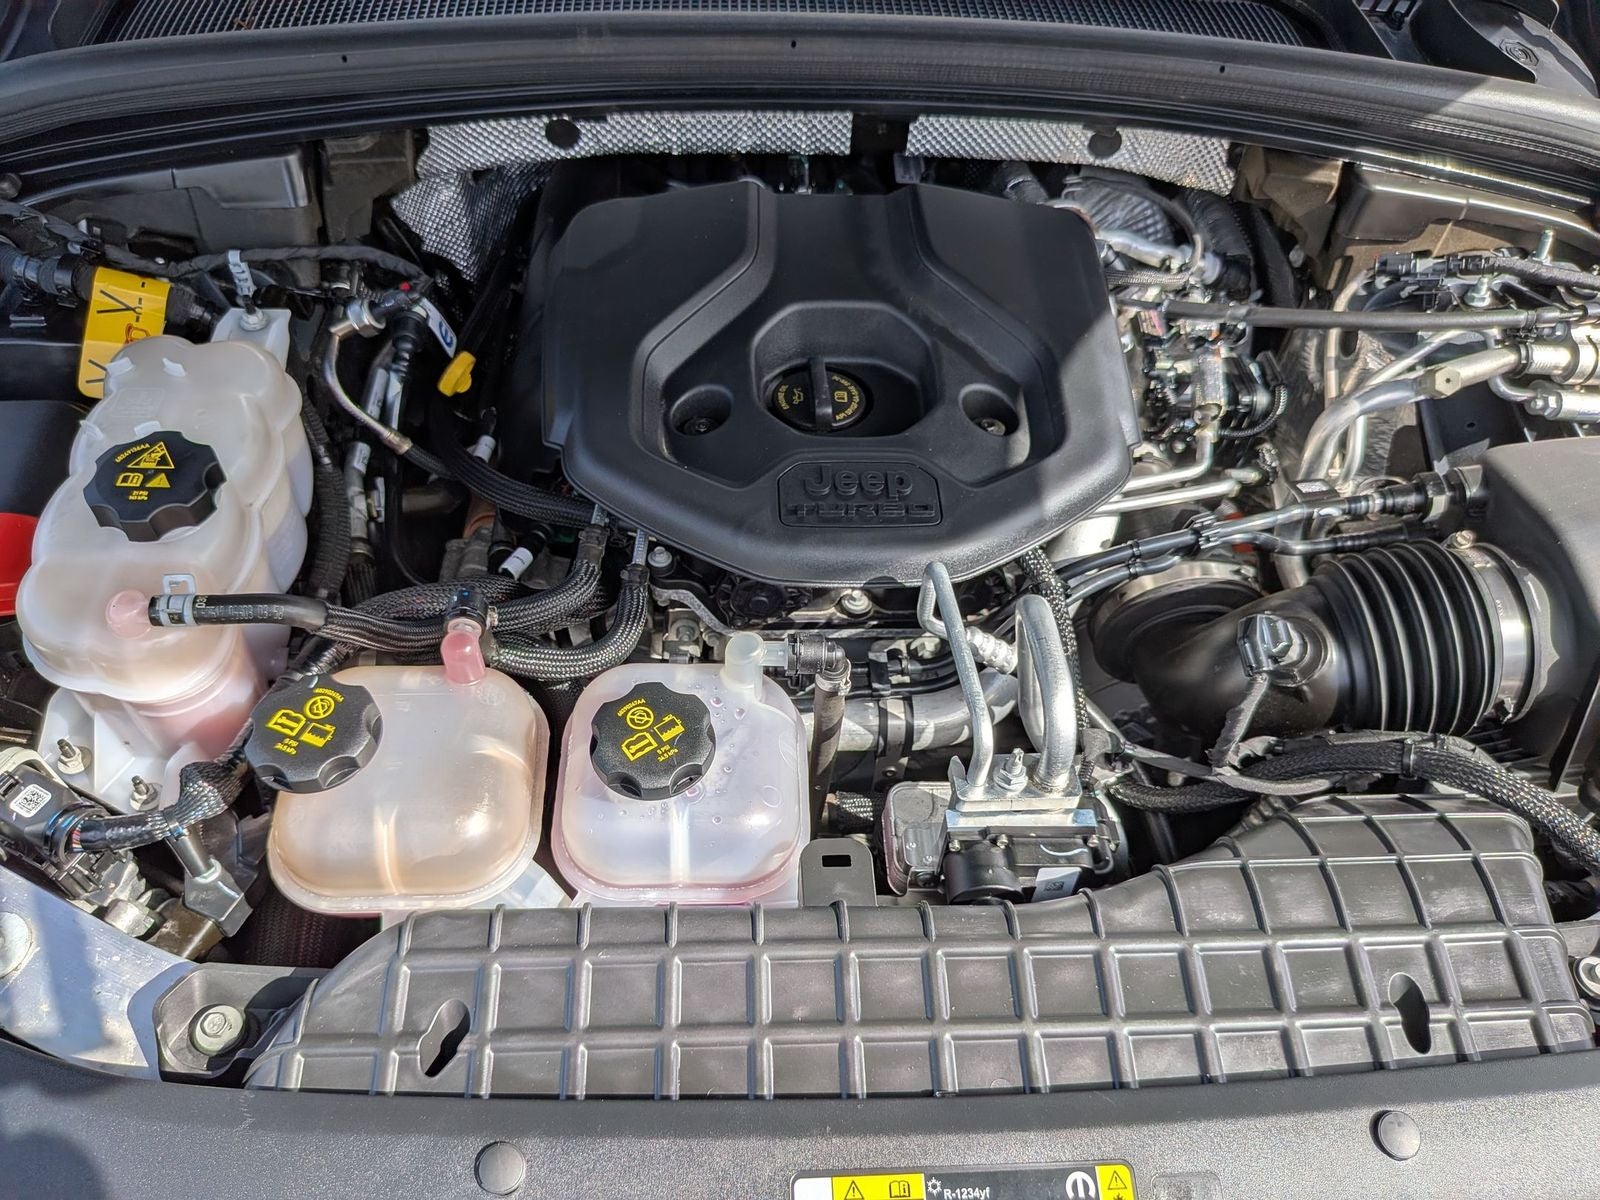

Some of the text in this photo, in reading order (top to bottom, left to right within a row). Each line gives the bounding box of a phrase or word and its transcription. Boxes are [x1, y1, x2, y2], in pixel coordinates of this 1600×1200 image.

[803, 464, 913, 501] Jeep
[785, 502, 936, 518] TURBO
[661, 744, 671, 752] PSI
[943, 1186, 991, 1200] R-1234yf
